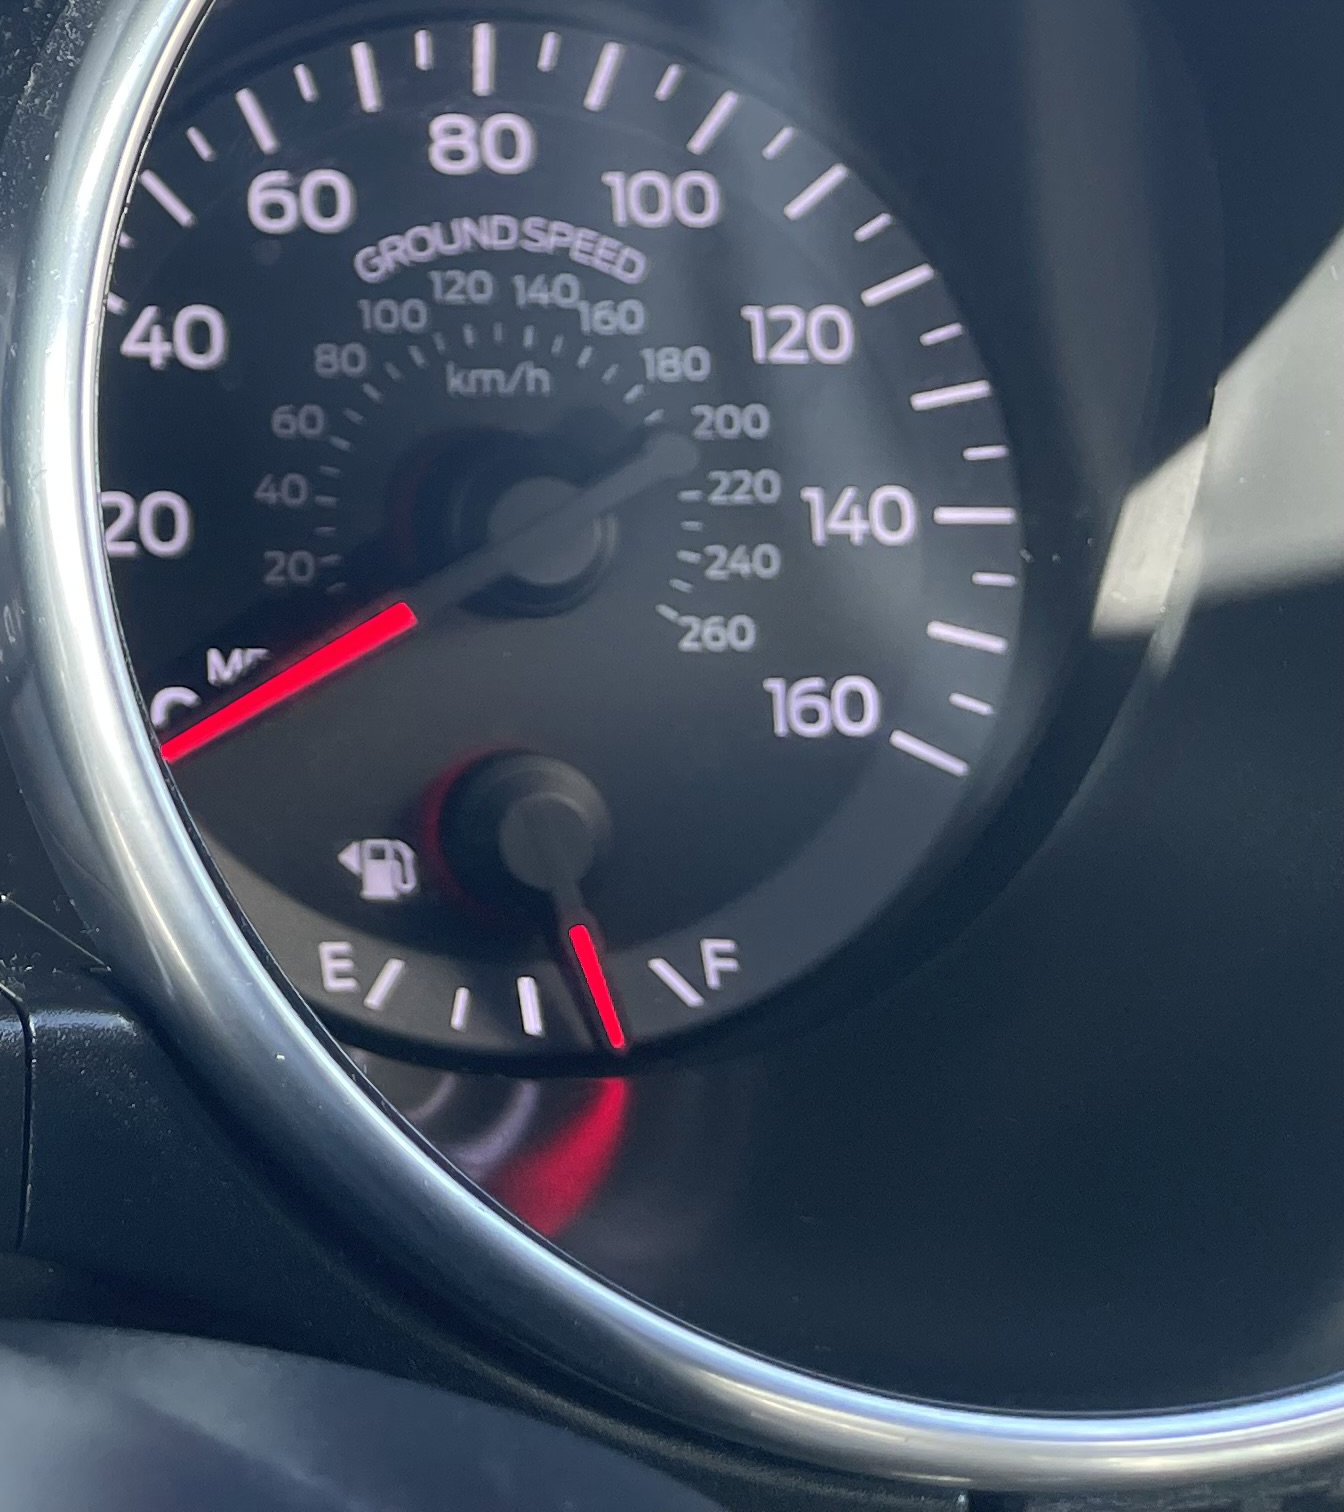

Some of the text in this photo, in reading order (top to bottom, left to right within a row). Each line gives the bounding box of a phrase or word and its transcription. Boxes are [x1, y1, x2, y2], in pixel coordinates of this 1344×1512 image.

[428, 112, 535, 175] 80
[247, 169, 356, 234] 60
[601, 169, 720, 228] 100
[428, 270, 494, 305] 120
[513, 273, 580, 309] 140
[357, 298, 428, 333] 100
[577, 299, 645, 335] 160
[741, 304, 854, 364] 120
[120, 304, 229, 370] 40
[315, 343, 367, 378] 80
[446, 360, 550, 397] km/h
[642, 346, 711, 382] 180
[271, 404, 326, 438] 60
[691, 403, 770, 440] 200
[254, 473, 309, 509] 40
[708, 468, 781, 504] 220
[100, 490, 192, 559] 20
[801, 485, 914, 546] 140
[263, 550, 315, 585] 20
[704, 544, 780, 580] 240
[678, 615, 757, 652] 260
[763, 674, 881, 738] 160
[319, 941, 358, 991] E
[699, 938, 740, 990] F
